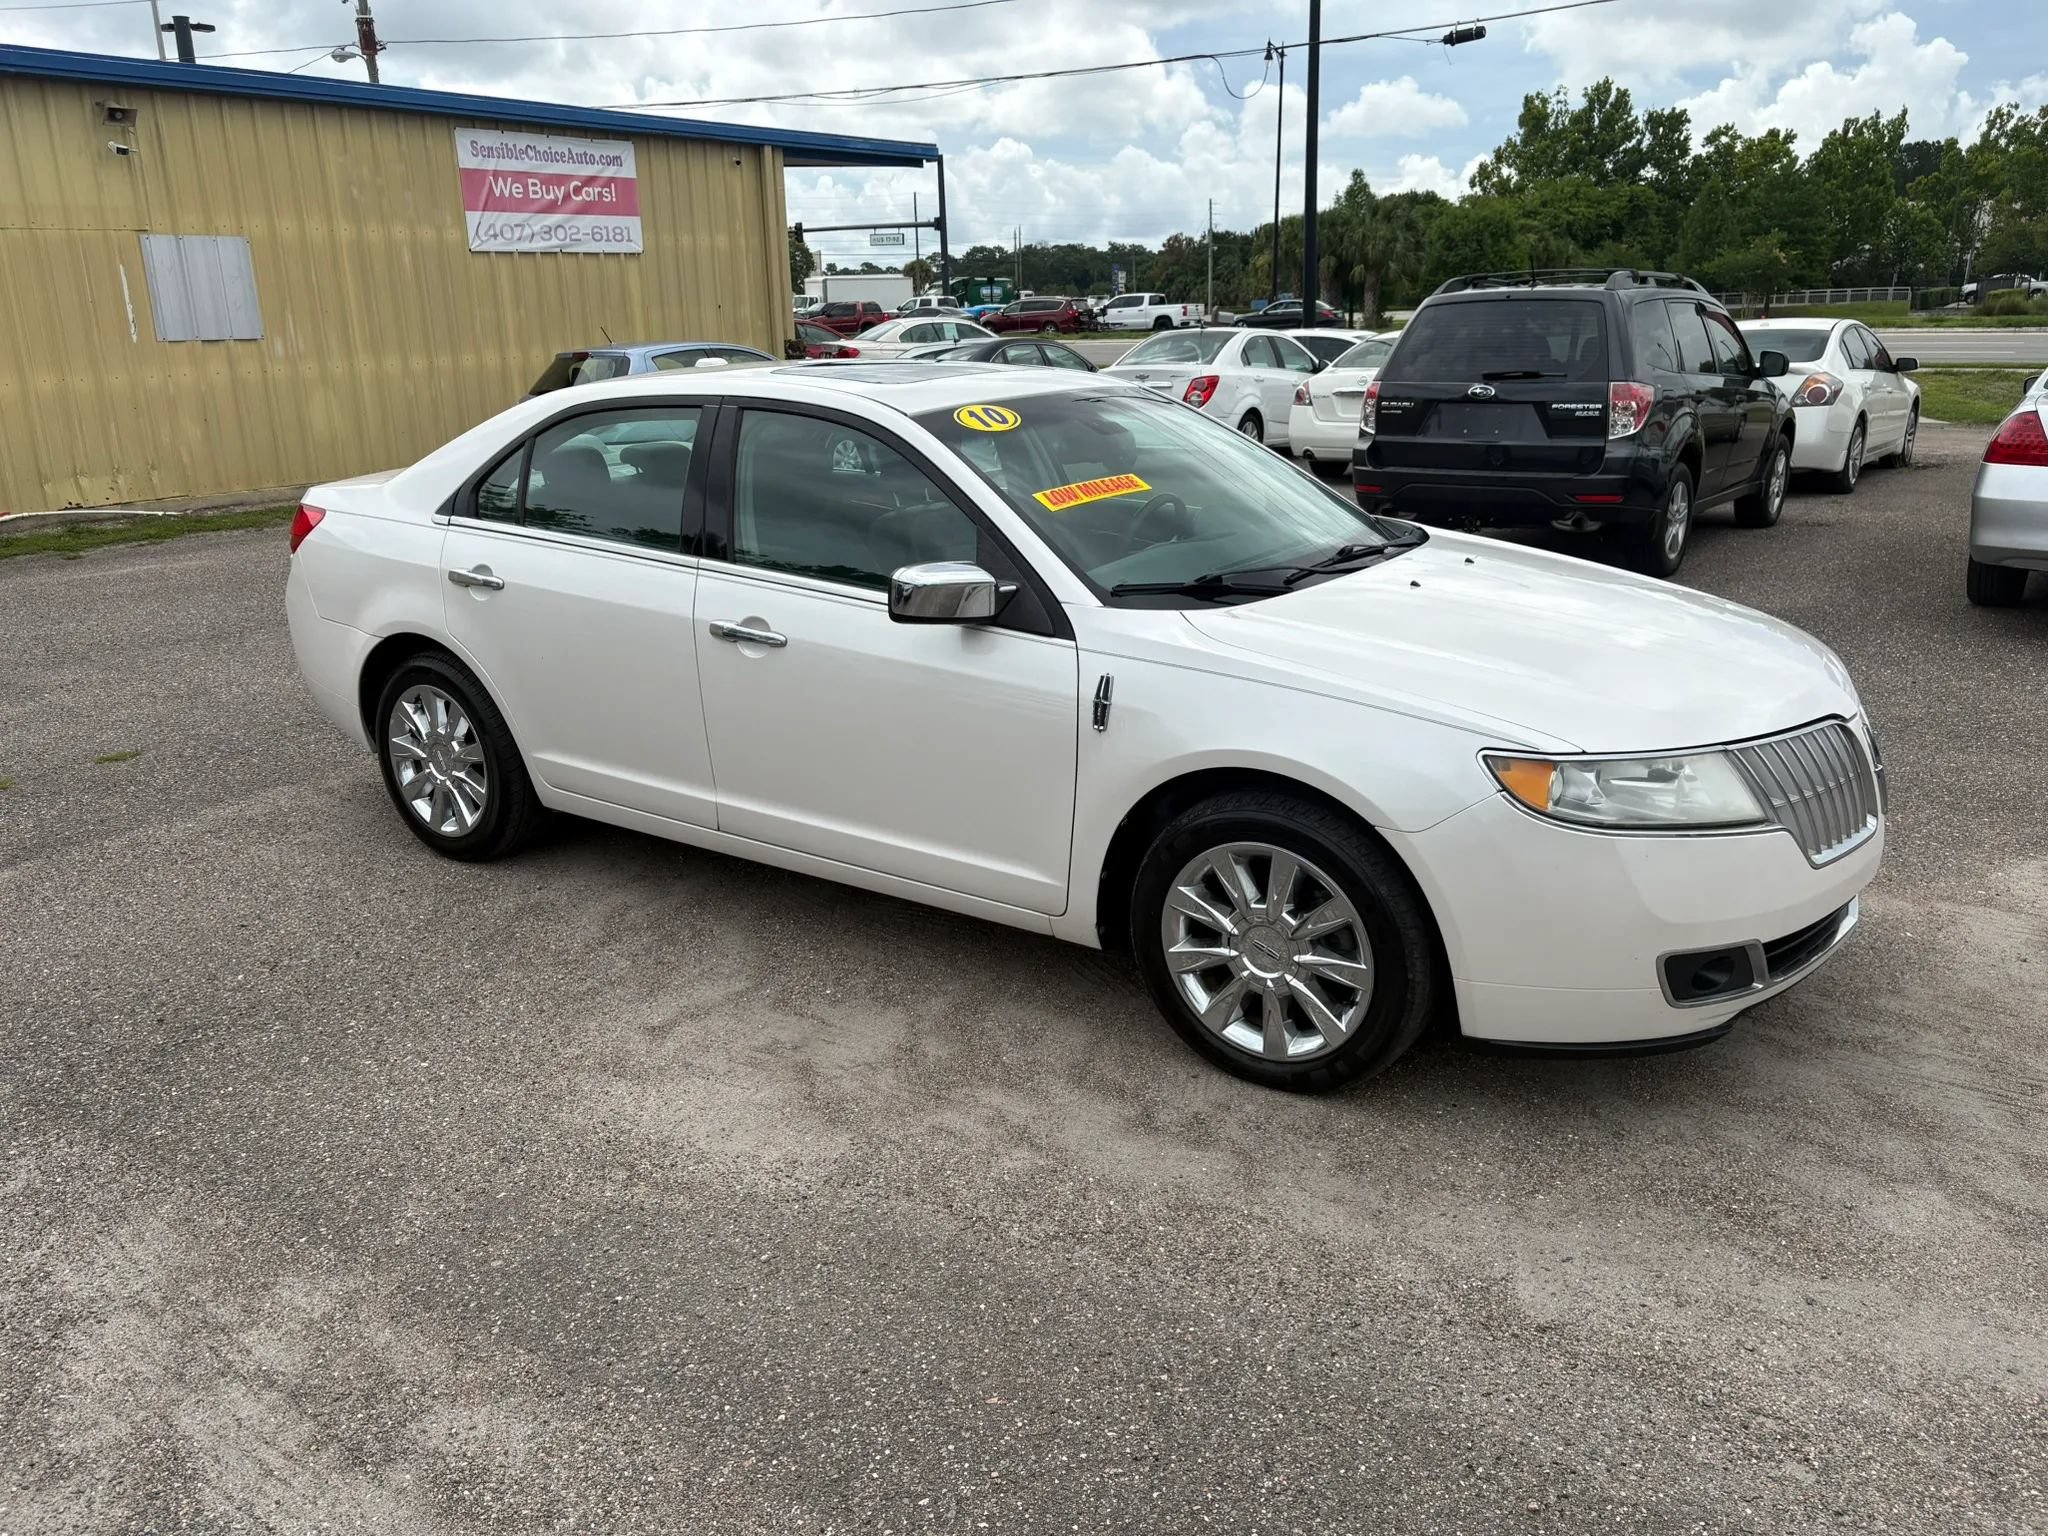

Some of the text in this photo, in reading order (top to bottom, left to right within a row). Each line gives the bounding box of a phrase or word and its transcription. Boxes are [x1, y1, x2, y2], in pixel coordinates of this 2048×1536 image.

[470, 140, 623, 168] SensibleChoiceAuto.com
[489, 176, 617, 206] We Buy Cars!
[475, 221, 633, 245] (407) 302-6181
[967, 406, 1010, 428] 10
[1042, 475, 1144, 506] LOW MILEAGE
